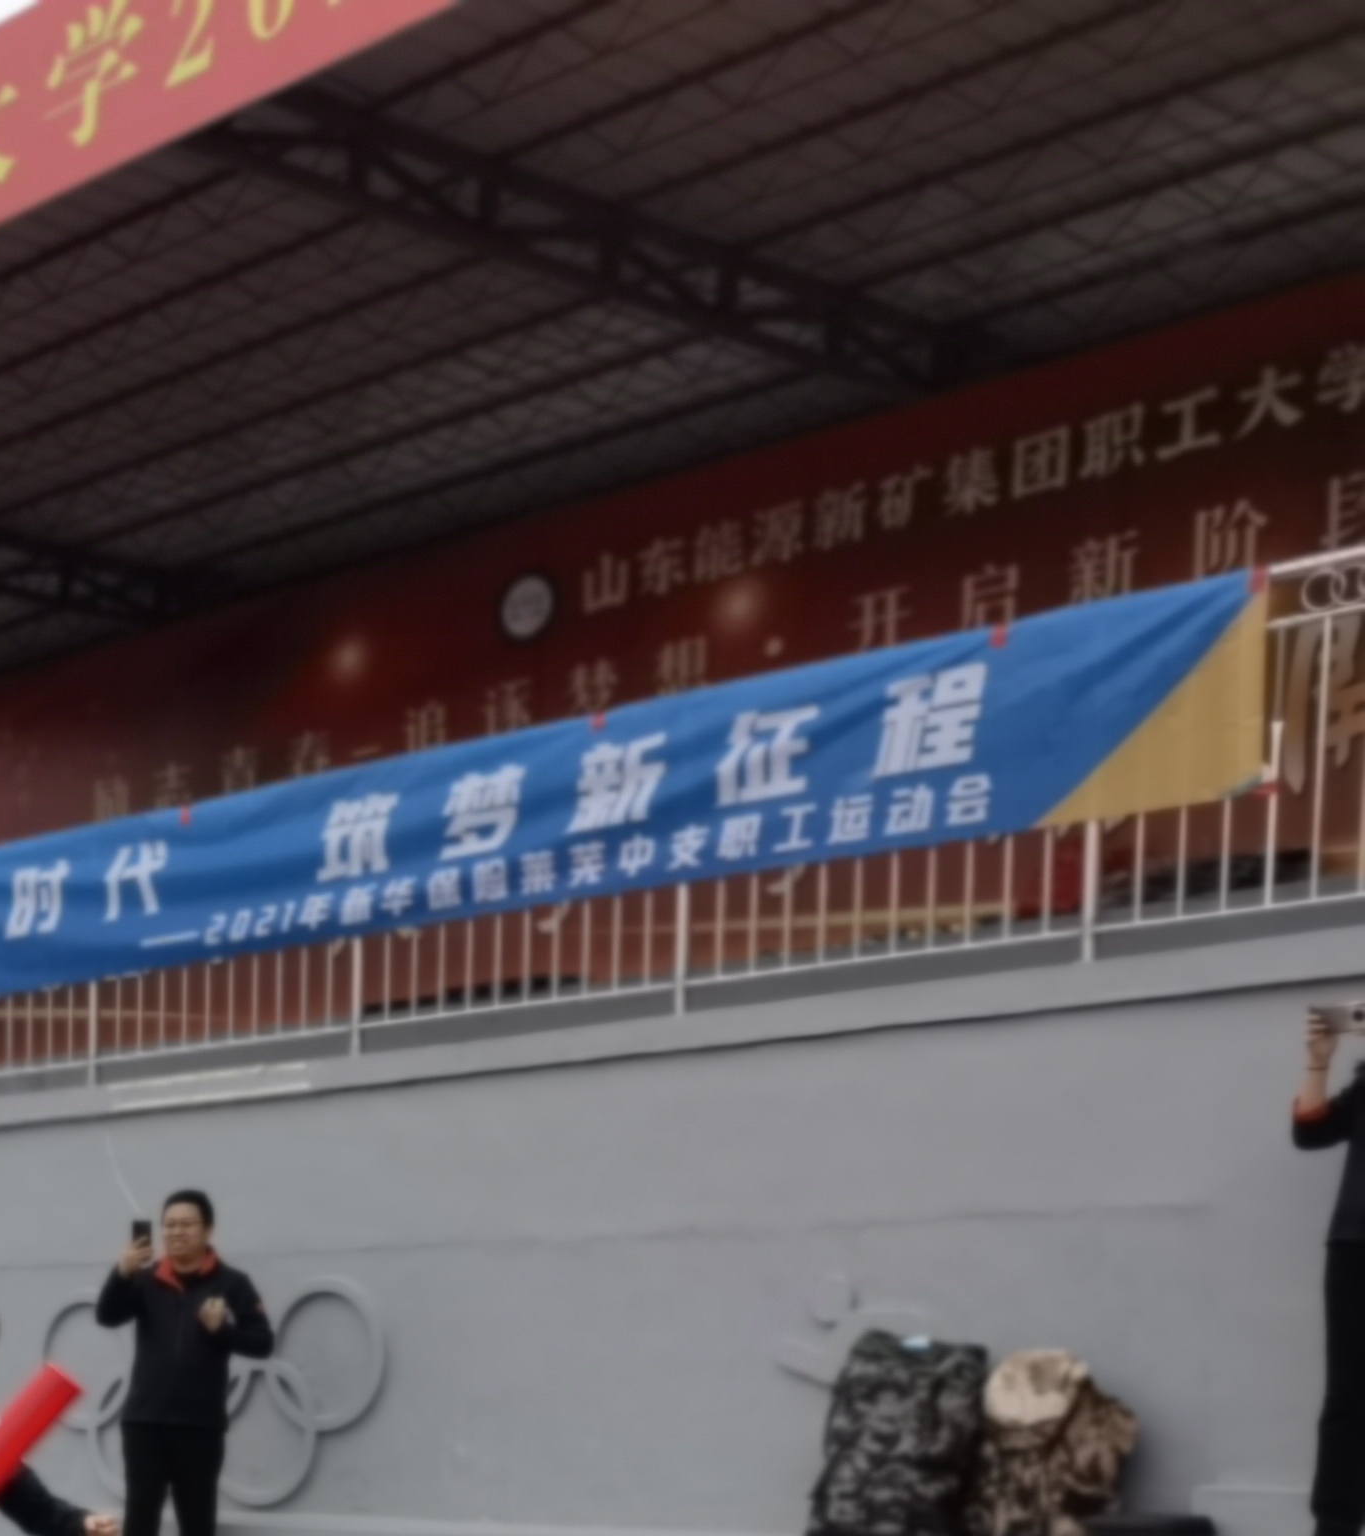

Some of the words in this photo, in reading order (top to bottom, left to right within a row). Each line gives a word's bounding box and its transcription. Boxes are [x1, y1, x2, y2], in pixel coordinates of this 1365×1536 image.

[580, 343, 1365, 614] 山东能源新矿集团职工大学
[316, 661, 991, 883] 筑梦新征程
